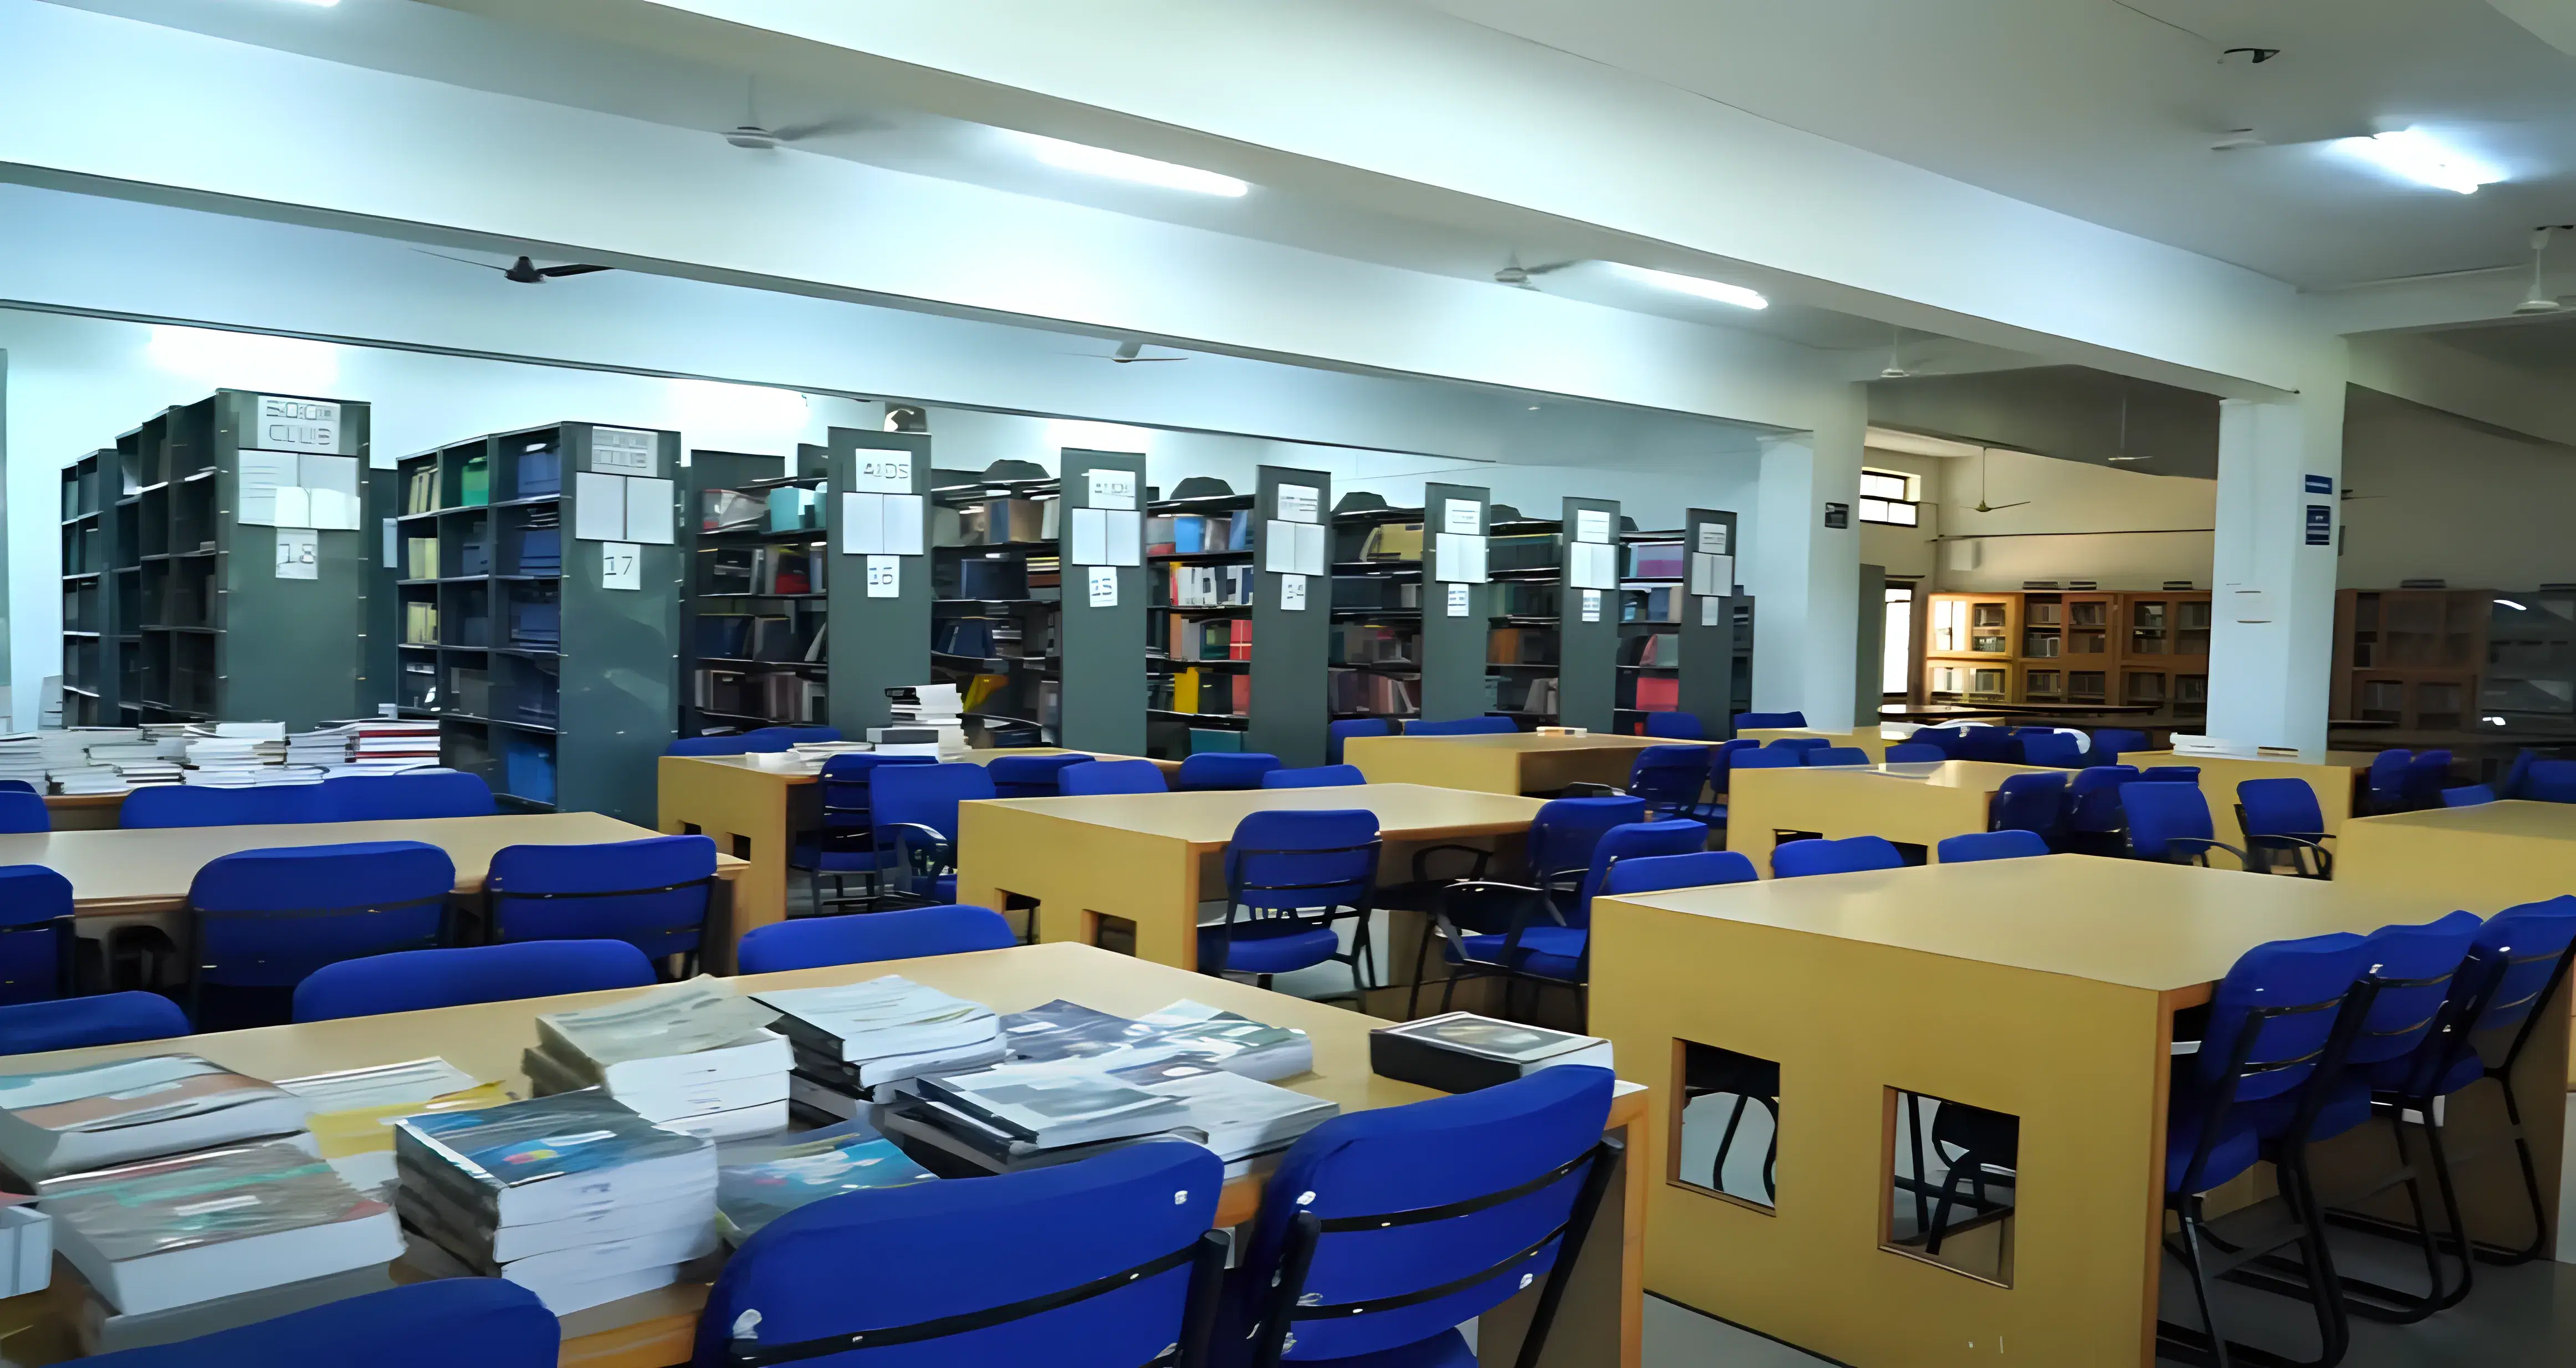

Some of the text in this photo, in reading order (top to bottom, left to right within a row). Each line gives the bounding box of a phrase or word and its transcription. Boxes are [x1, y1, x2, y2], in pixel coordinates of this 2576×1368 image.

[604, 556, 632, 575] 17
[868, 566, 893, 585] 16
[1091, 578, 1112, 596] 15
